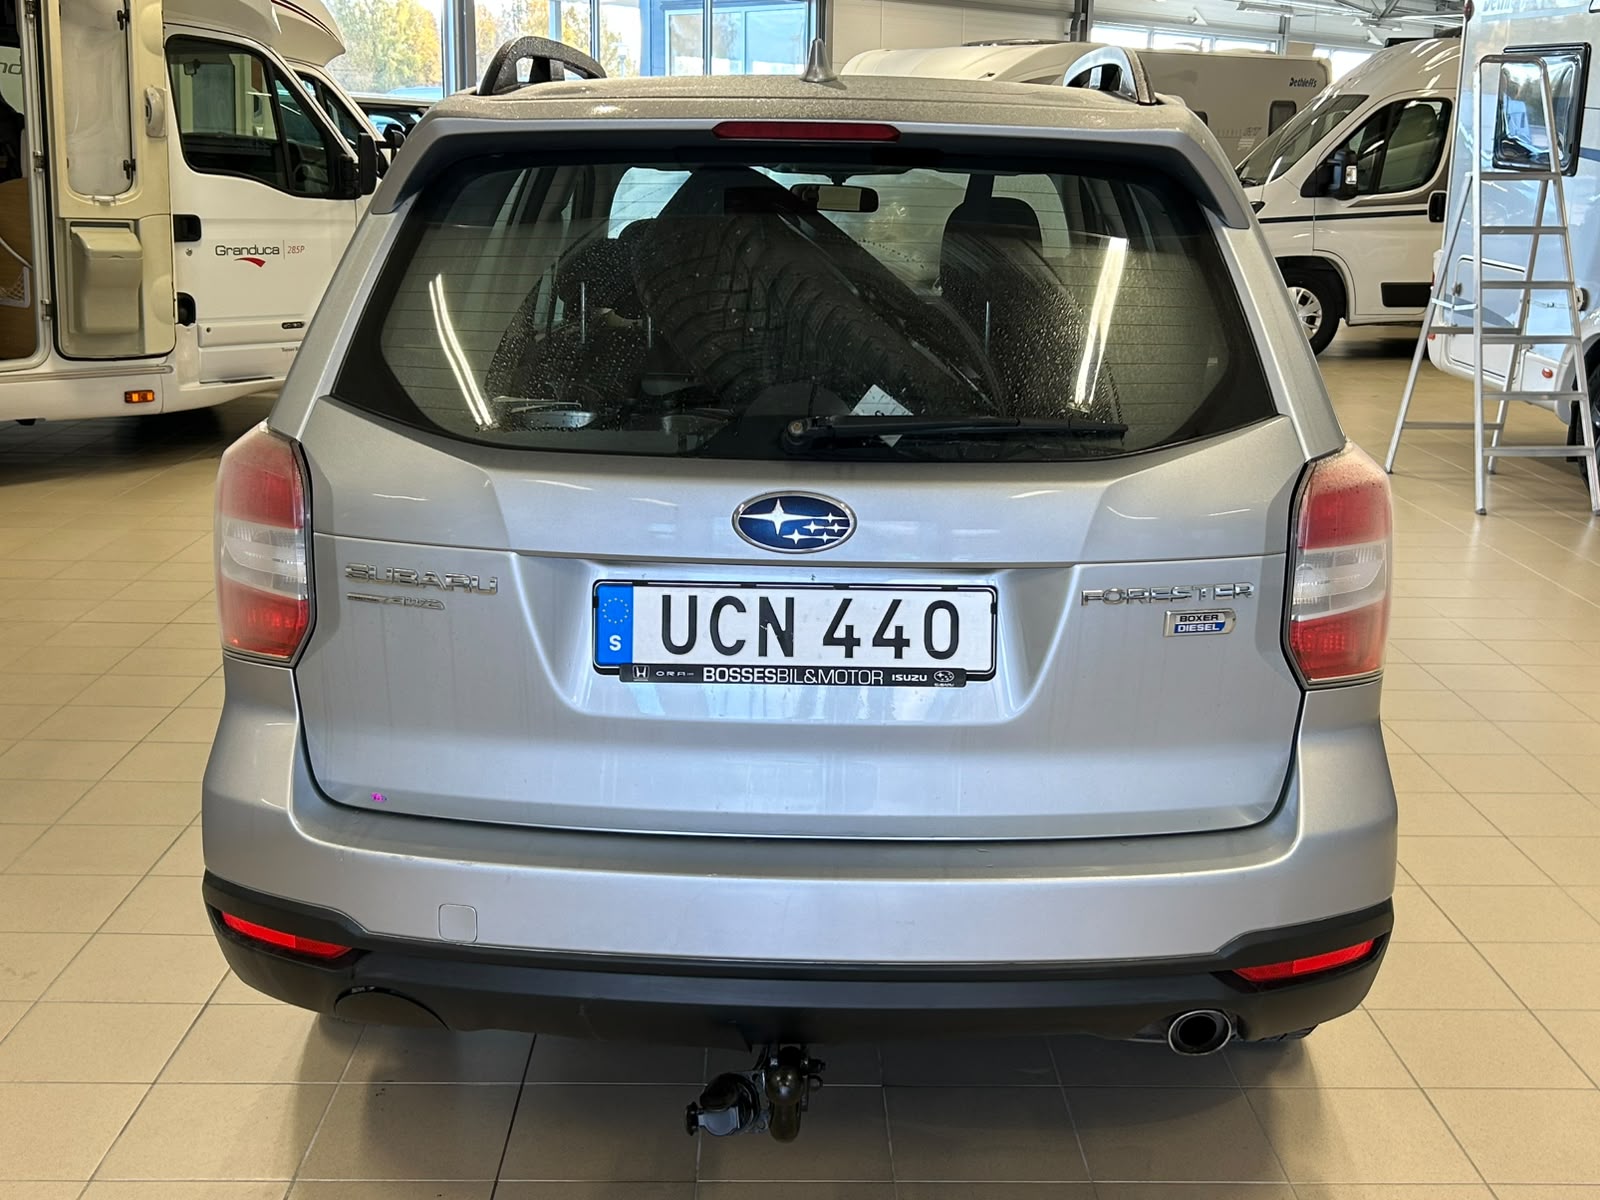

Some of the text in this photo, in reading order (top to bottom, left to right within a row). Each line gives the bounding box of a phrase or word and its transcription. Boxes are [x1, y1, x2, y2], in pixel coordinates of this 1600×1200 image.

[215, 244, 305, 256] Granduca 285P
[345, 563, 499, 595] SUBARU
[1081, 582, 1255, 606] FORESTER
[1179, 614, 1219, 623] BOXER
[661, 594, 960, 661] UCN 440
[1177, 623, 1220, 633] DIESEL
[609, 634, 622, 651] S
[892, 674, 928, 682] ISUZU
